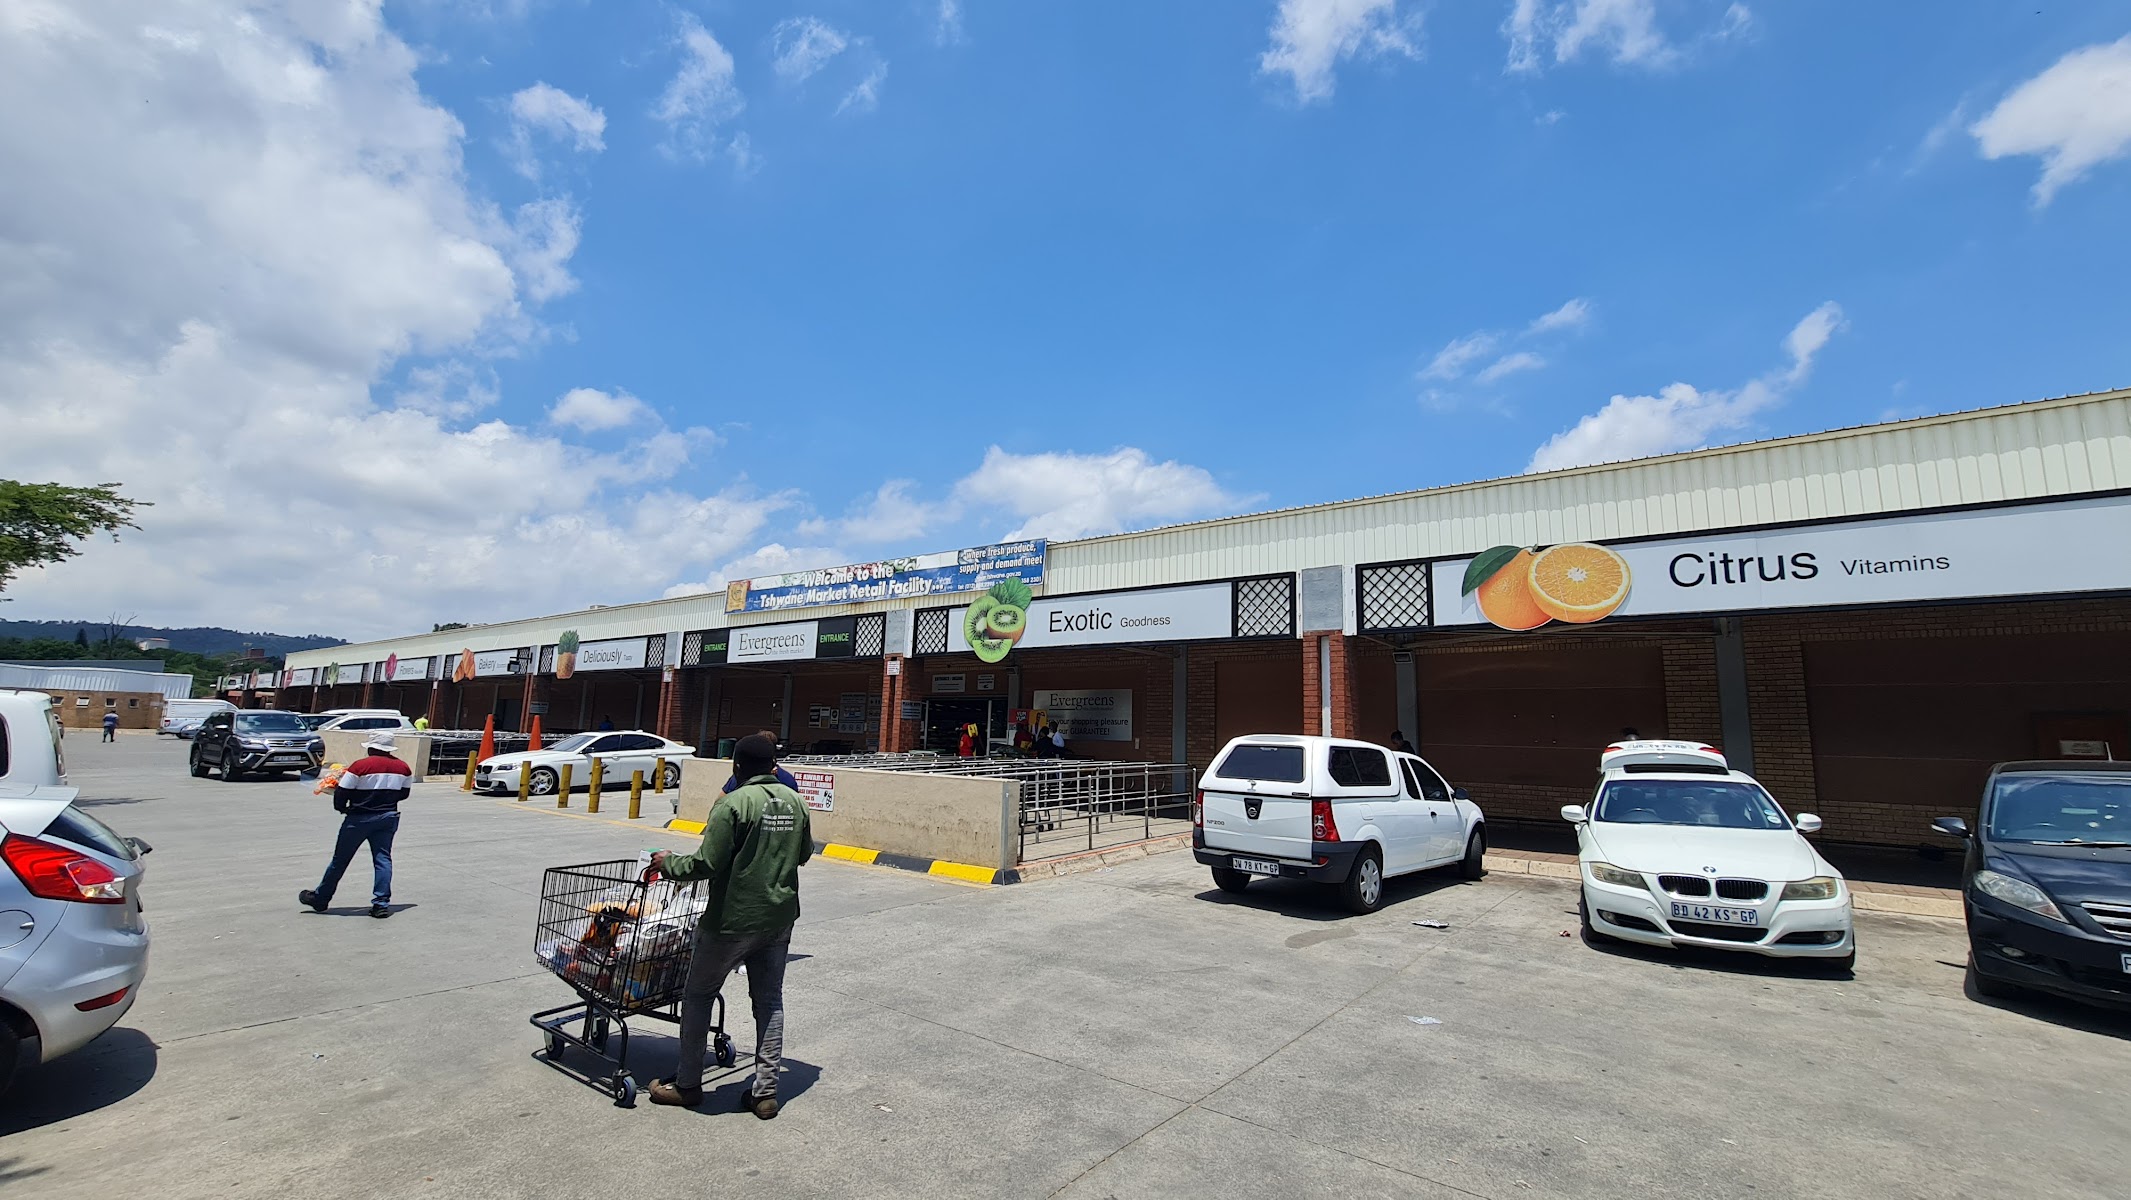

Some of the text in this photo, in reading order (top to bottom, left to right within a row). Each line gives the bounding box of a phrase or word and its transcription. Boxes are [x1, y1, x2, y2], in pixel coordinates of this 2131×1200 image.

[966, 543, 1036, 559] where fresh produce,
[959, 554, 1043, 575] supply and demand meet
[1669, 551, 1950, 588] Citrus Vitamins
[803, 561, 894, 588] Welcome to the
[760, 576, 944, 608] Tshwane Market Retail Facility...
[1049, 607, 1171, 633] Exotic Goodness
[704, 642, 727, 652] ENTRANCE
[738, 632, 805, 656] Evergreens
[820, 632, 850, 644] ENTRANCE
[478, 658, 497, 670] Bakery
[583, 647, 622, 665] Deliciously
[1049, 693, 1115, 711] Evergreens
[1071, 718, 1099, 727] shopping
[1100, 718, 1128, 726] pleasure
[1070, 728, 1110, 736] GUARANTEE!
[803, 773, 824, 781] AWARE
[1244, 860, 1252, 870] 78
[1255, 862, 1262, 871] KT
[1270, 864, 1278, 874] GP
[1673, 904, 1755, 923] BD 42 KS GP
